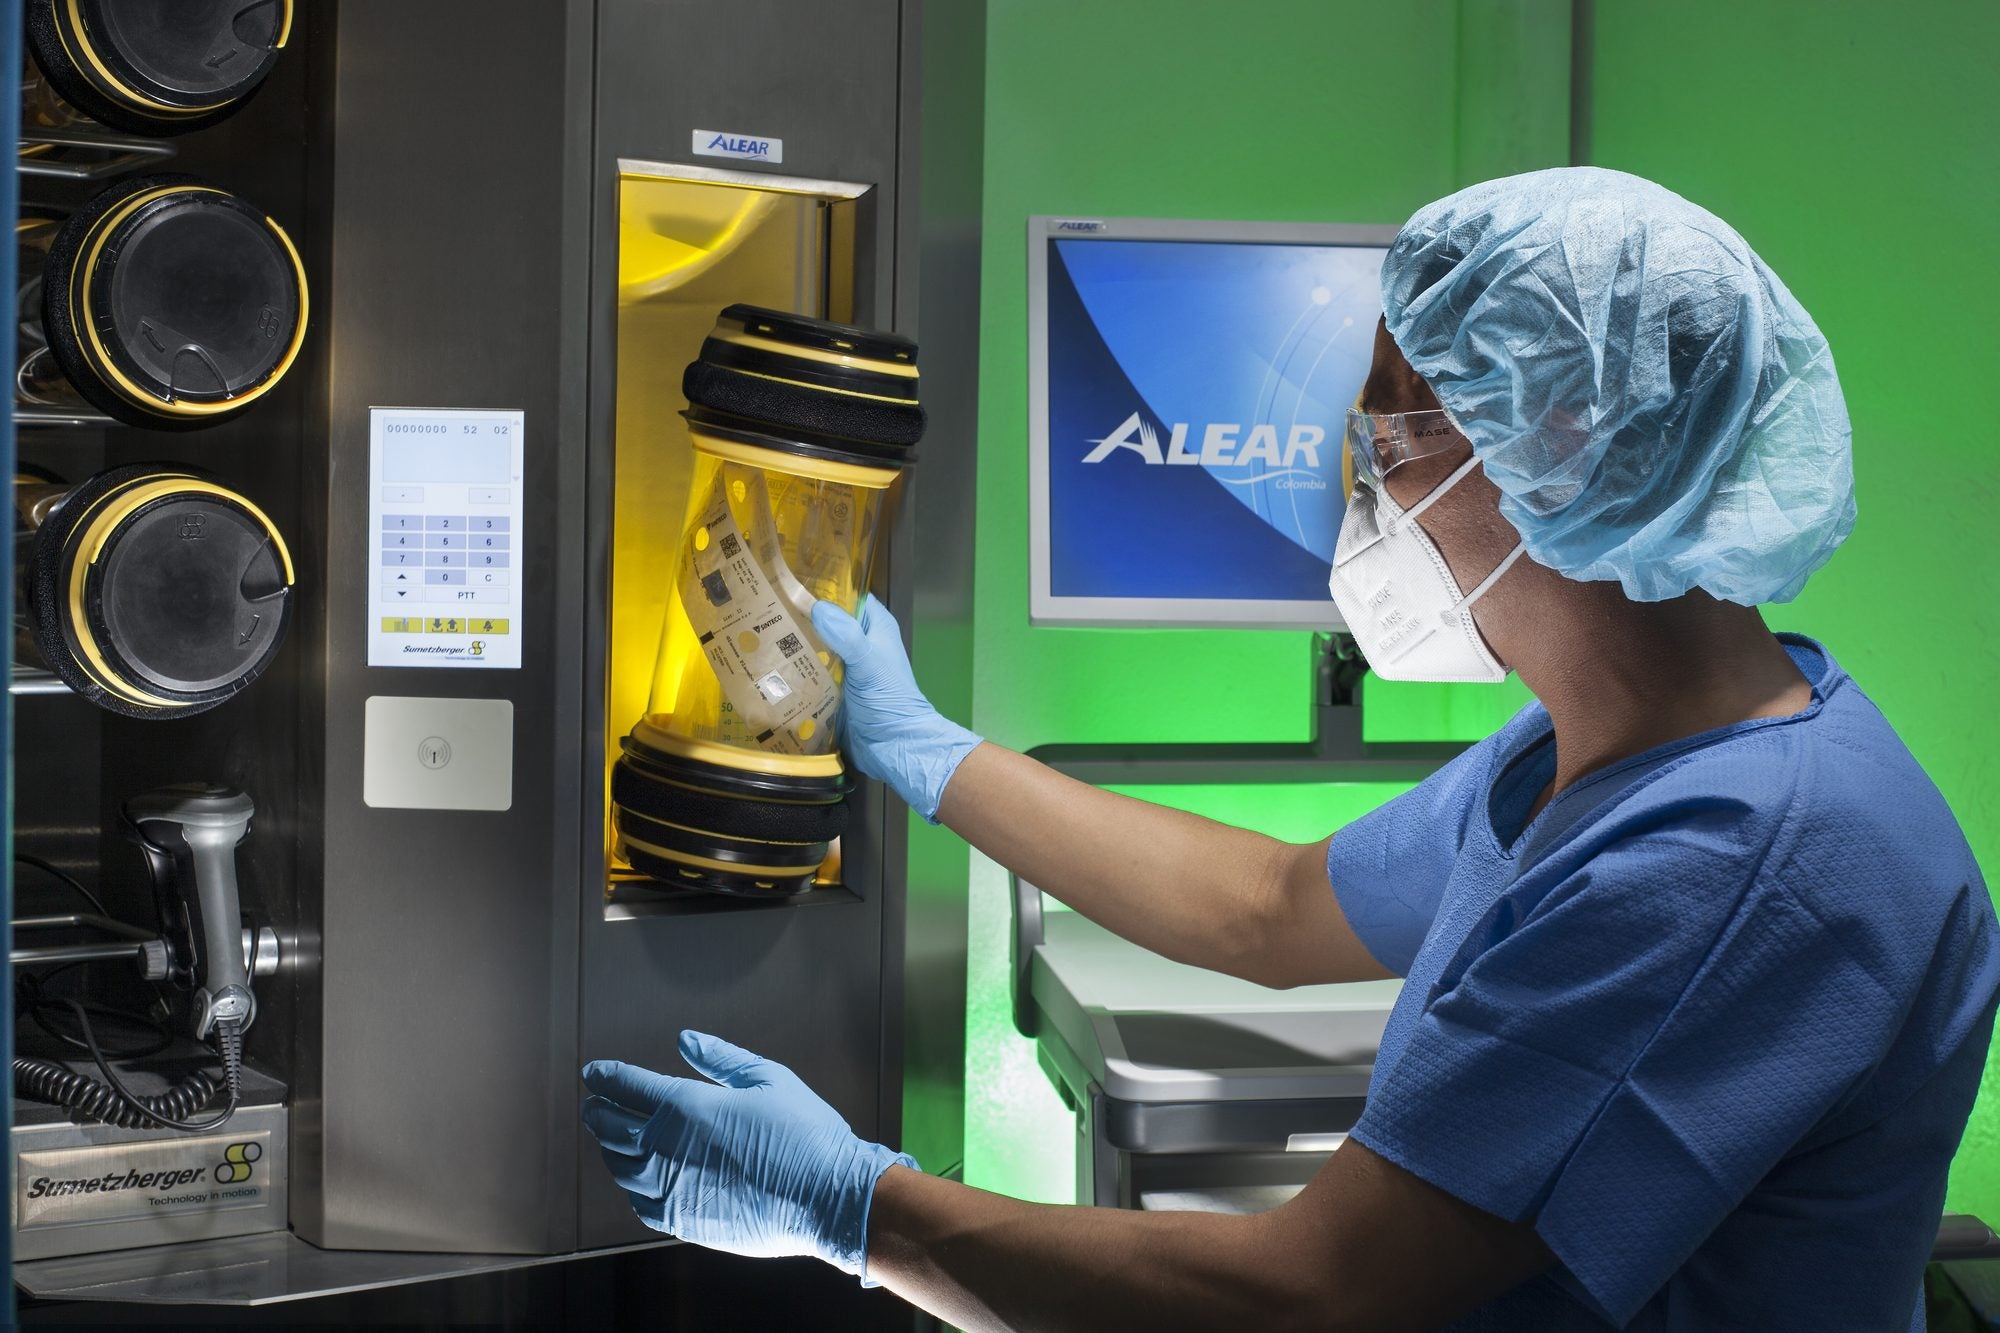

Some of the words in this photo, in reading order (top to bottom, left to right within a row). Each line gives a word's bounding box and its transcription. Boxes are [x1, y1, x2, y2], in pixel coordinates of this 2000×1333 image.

[707, 134, 769, 155] ALEAR
[387, 424, 447, 434] 00000000
[463, 425, 478, 435] 52
[494, 426, 509, 435] 02
[1081, 411, 1326, 468] ALEAR
[1275, 478, 1327, 491] Colombia
[400, 519, 405, 528] 1
[443, 520, 449, 528] 2
[486, 520, 492, 528] 3
[399, 537, 405, 545] 4
[443, 537, 449, 546] 5
[486, 538, 492, 546] 6
[400, 555, 405, 563] 7
[443, 555, 449, 564] 8
[486, 556, 492, 564] 9
[442, 573, 449, 582] 0
[485, 574, 492, 582] C
[458, 592, 475, 600] PTT
[760, 614, 783, 631] SINTECO
[403, 645, 464, 655] Sumetzberger
[720, 702, 733, 713] 50
[28, 1166, 206, 1200] Sumetzberger
[149, 1193, 206, 1206] Technology
[210, 1191, 219, 1200] in
[222, 1187, 258, 1199] motion
